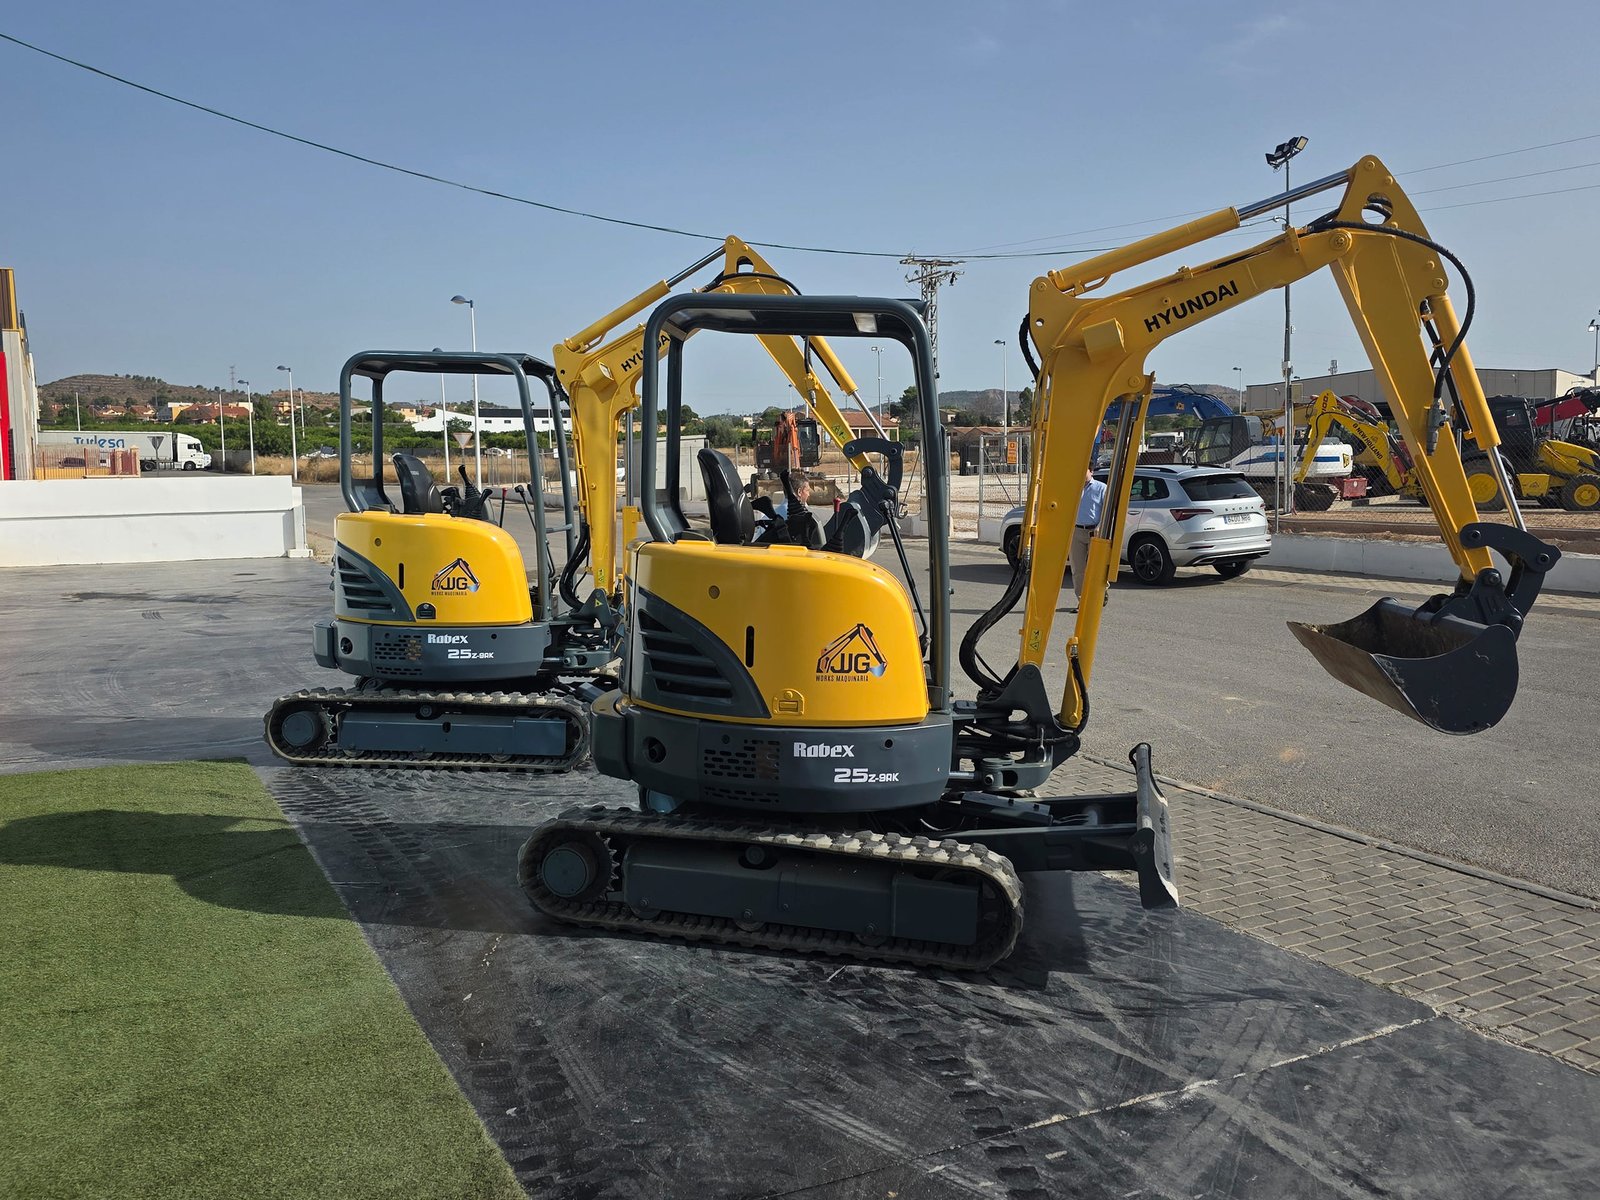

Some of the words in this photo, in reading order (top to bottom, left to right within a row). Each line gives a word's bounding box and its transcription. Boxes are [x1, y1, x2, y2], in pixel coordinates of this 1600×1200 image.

[1144, 280, 1239, 333] HYUNDAI
[1364, 437, 1383, 460] HOLLAND
[836, 675, 868, 683] MAQUINARIA
